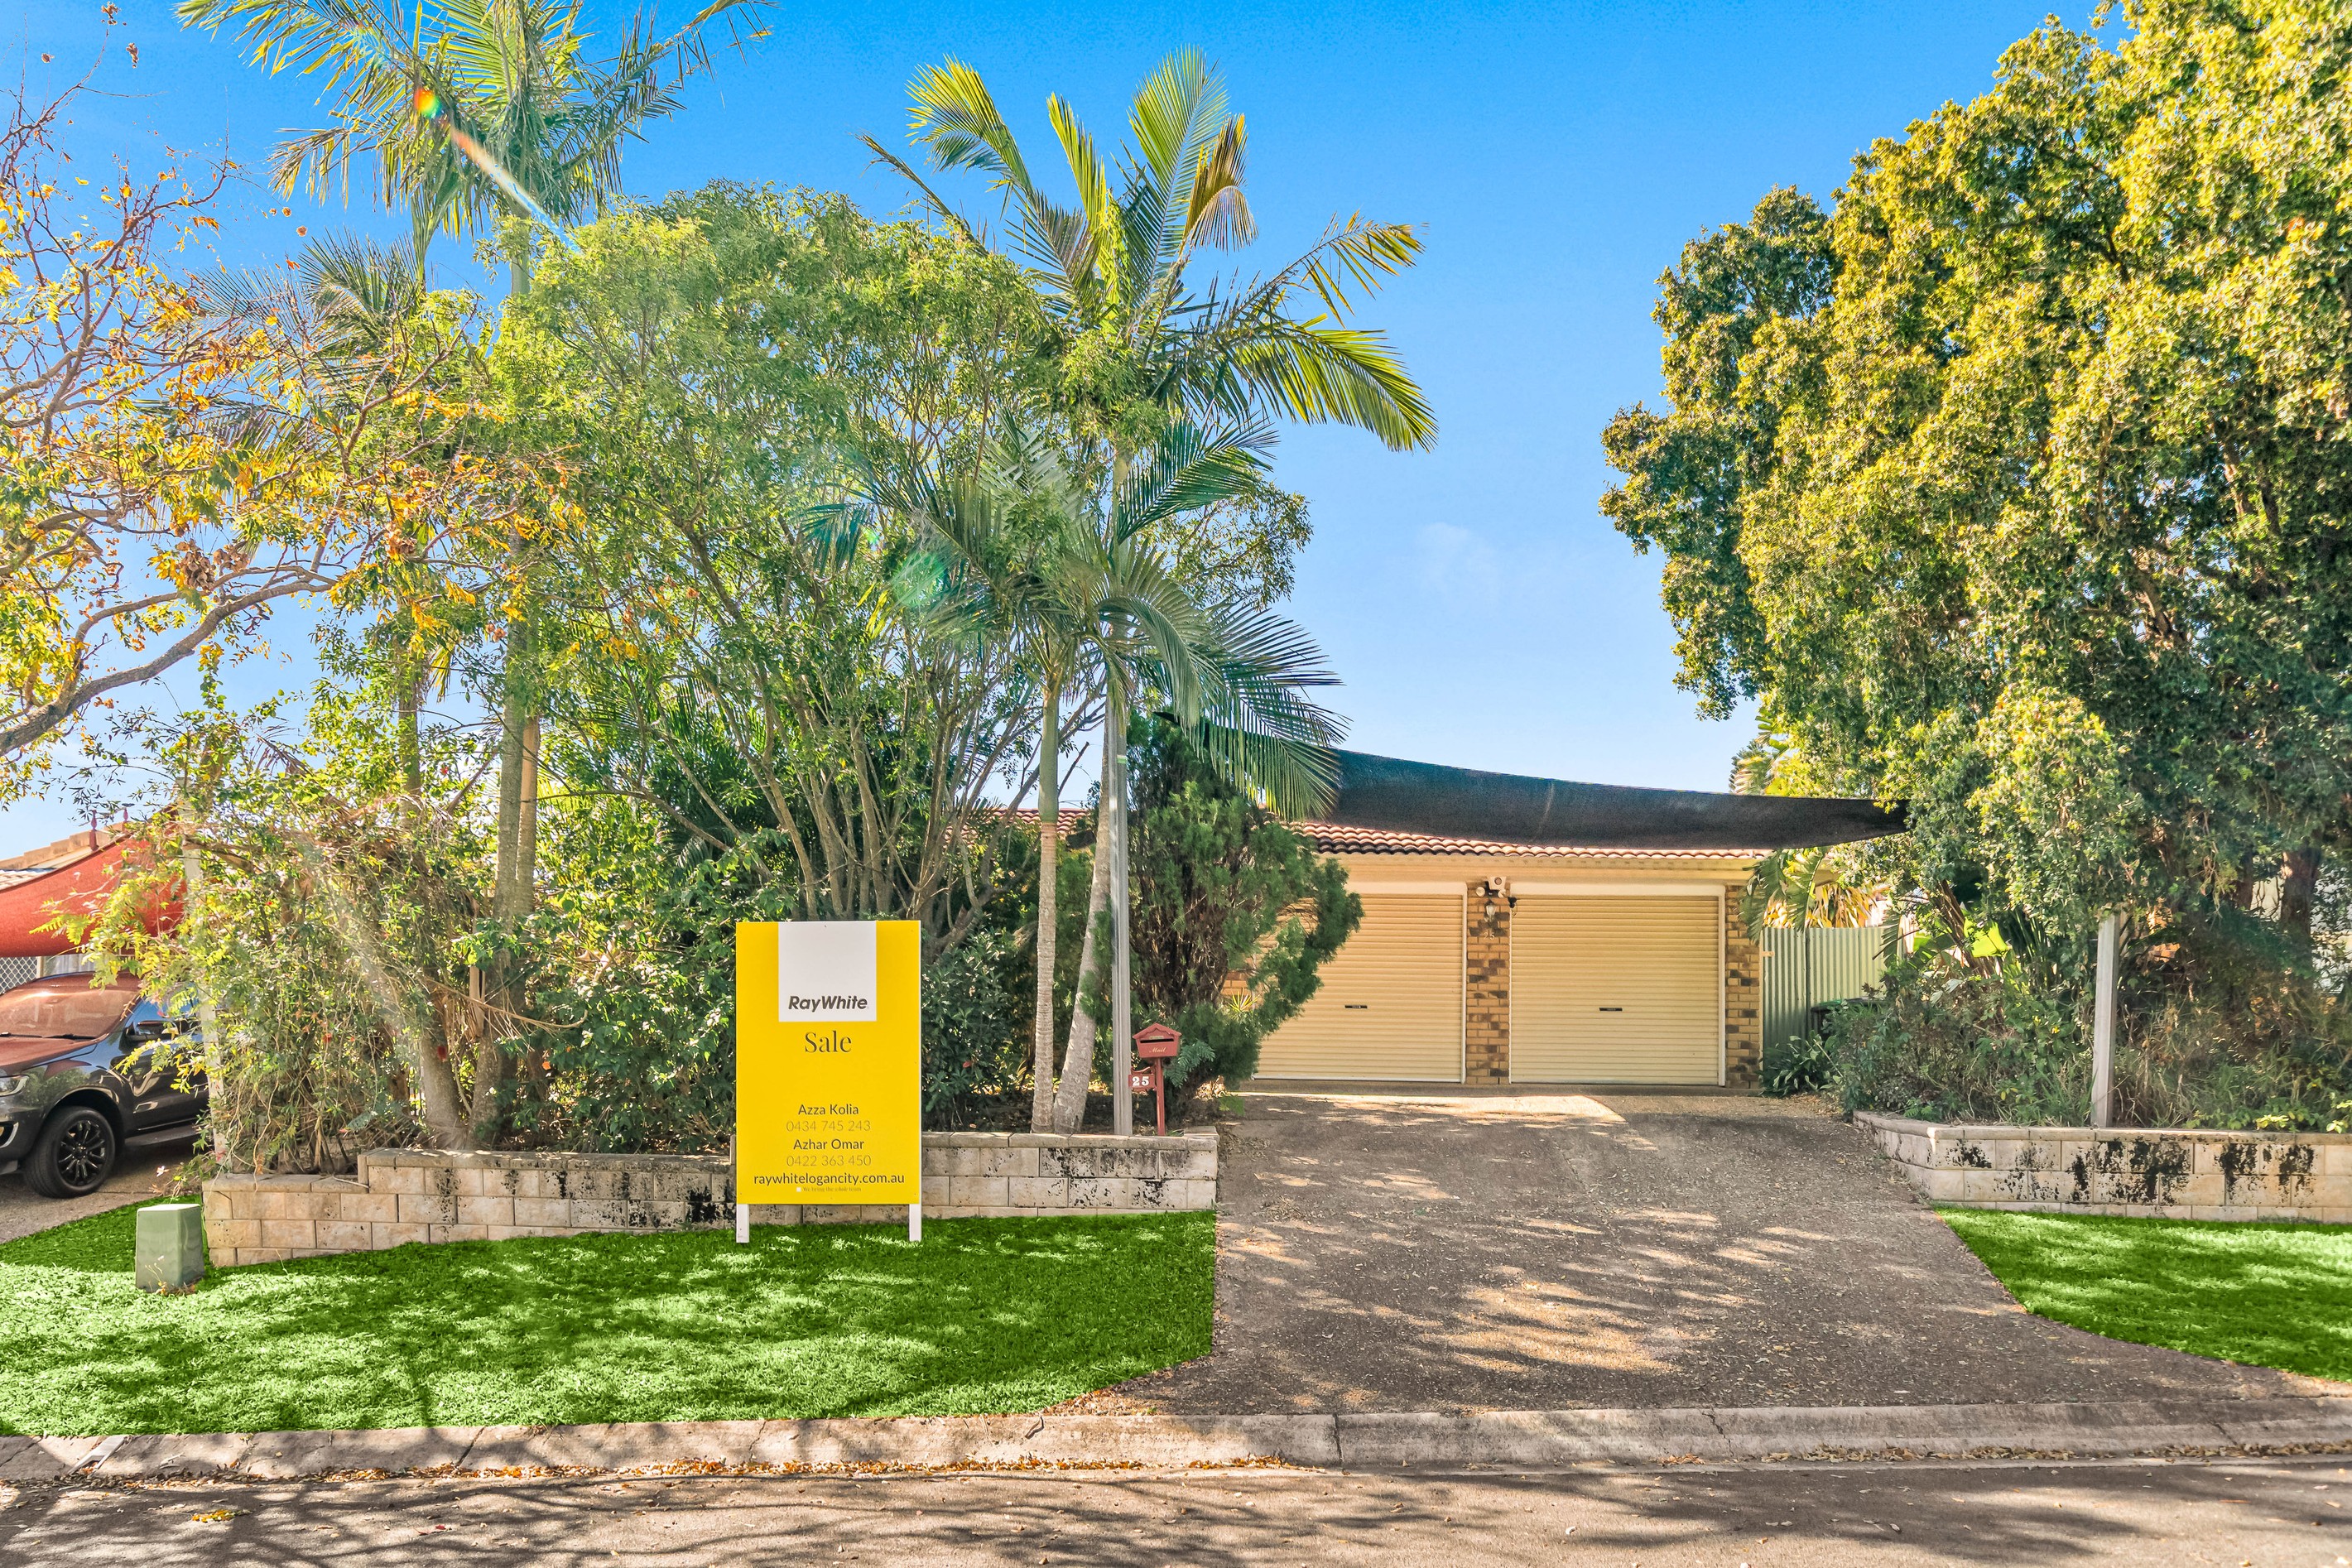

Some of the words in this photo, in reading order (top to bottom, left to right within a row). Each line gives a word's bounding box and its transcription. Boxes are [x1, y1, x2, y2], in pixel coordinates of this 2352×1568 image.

[788, 995, 868, 1012] RayWhite
[805, 1030, 852, 1053] Sale
[1132, 1075, 1149, 1086] 25
[798, 1104, 825, 1115] Azza
[830, 1104, 859, 1115] Kolia
[786, 1120, 816, 1132] 0434
[821, 1120, 844, 1132] 745
[848, 1119, 871, 1132] 243
[793, 1139, 828, 1150] Azhar
[831, 1138, 864, 1150] Omar
[786, 1155, 817, 1166] 0422
[821, 1155, 844, 1166] 363
[848, 1154, 872, 1166] 450
[753, 1172, 905, 1186] raywhitelogancity.com.au
